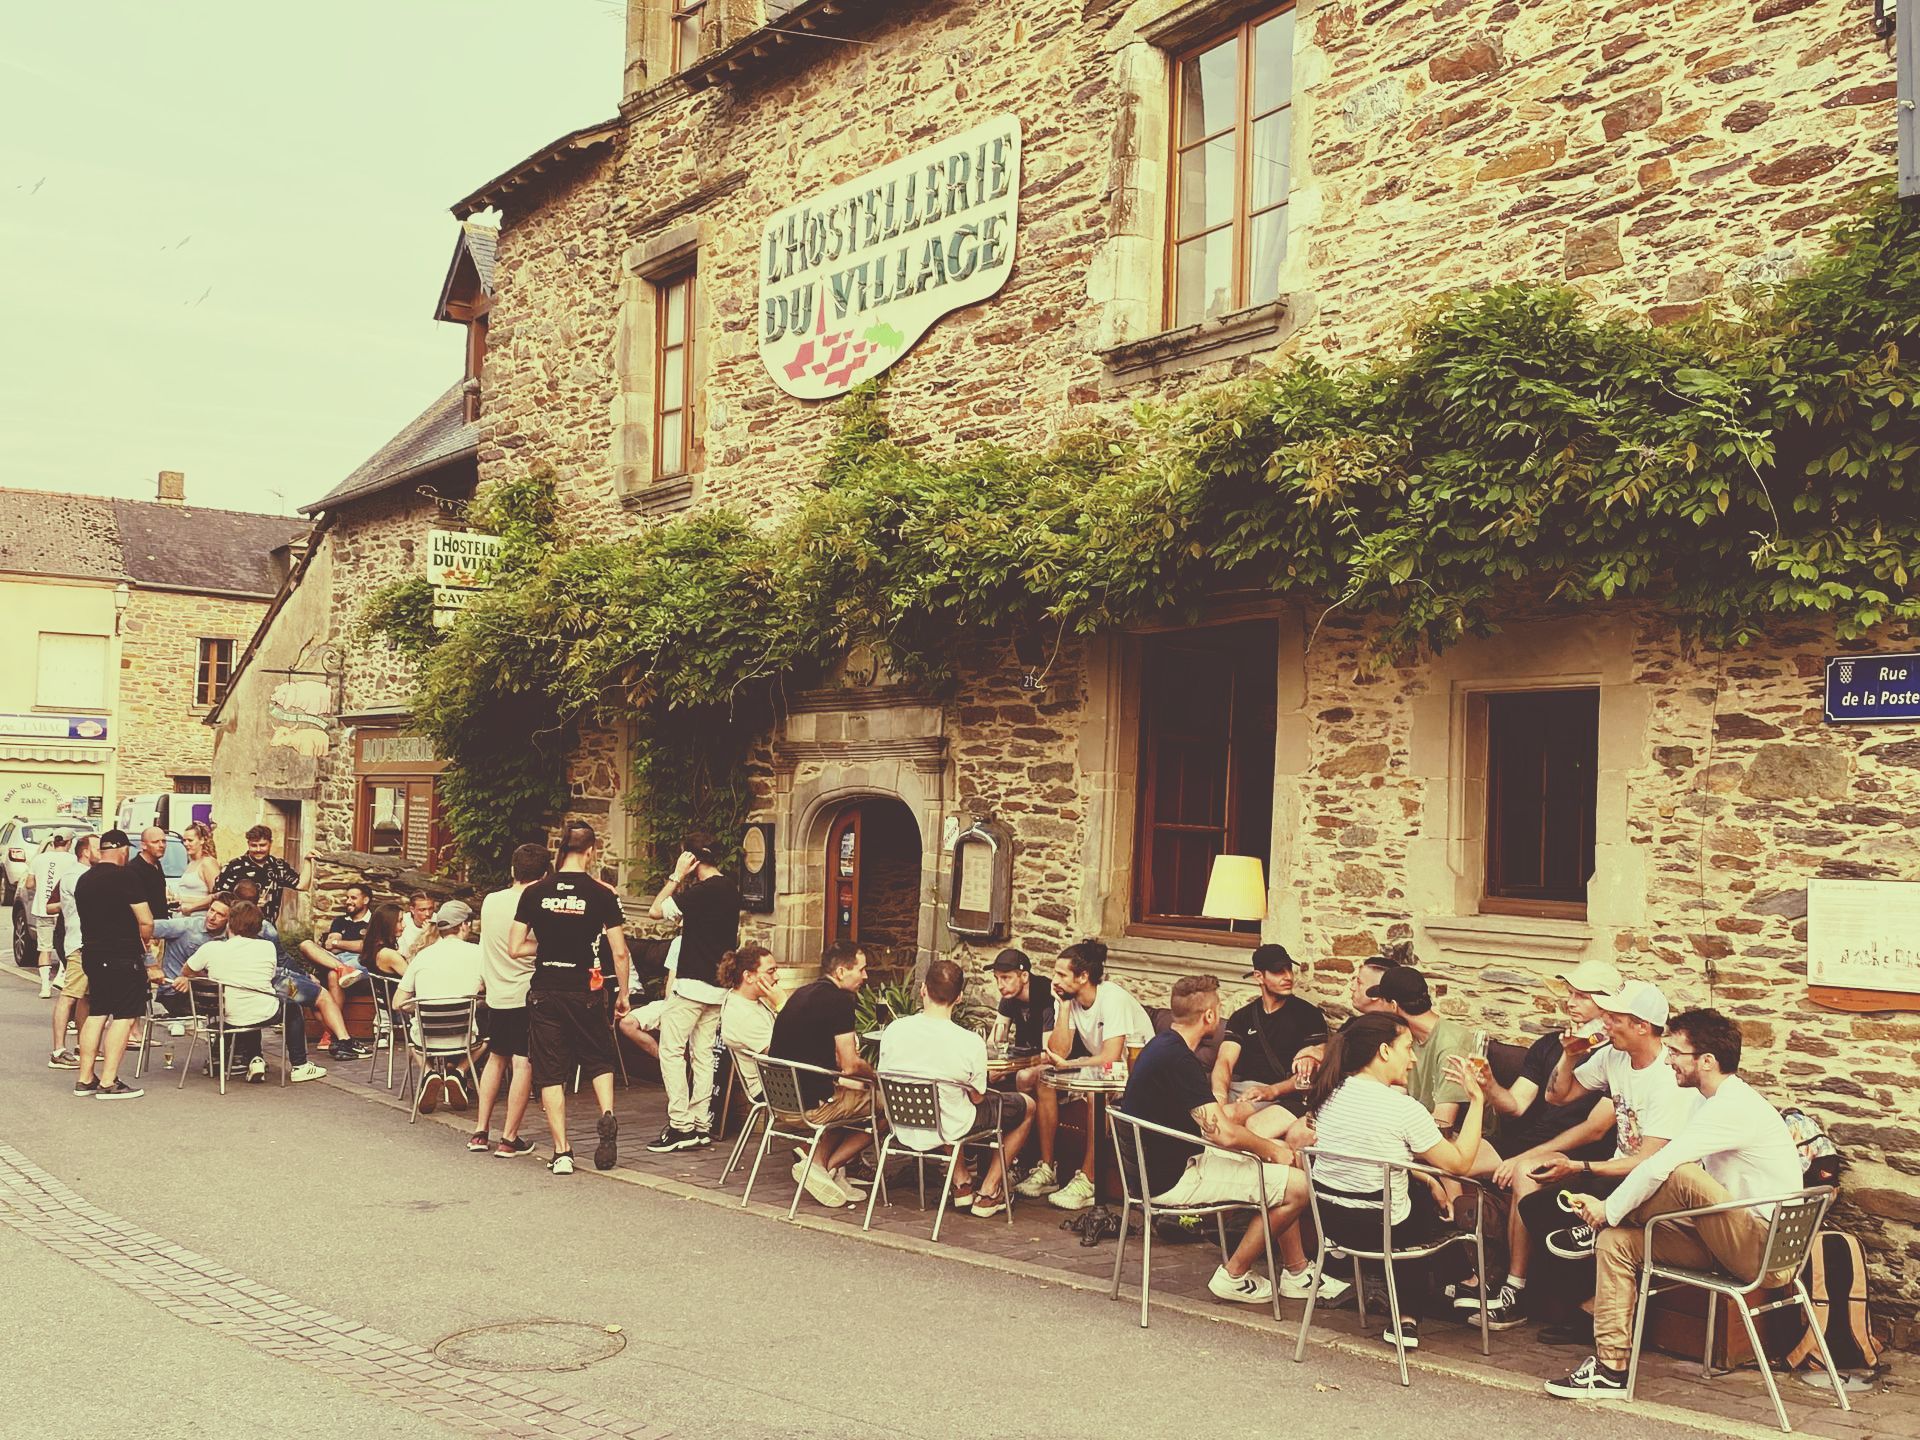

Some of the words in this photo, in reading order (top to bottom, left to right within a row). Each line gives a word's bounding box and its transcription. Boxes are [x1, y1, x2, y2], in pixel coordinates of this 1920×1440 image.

[766, 132, 1013, 286] L'HOSTELLERIE
[764, 281, 815, 345] DU
[829, 210, 1009, 321] VILLAGE
[433, 554, 455, 568] DU
[1879, 666, 1908, 681] Rue
[1841, 691, 1859, 706] de
[1863, 690, 1876, 706] la
[1880, 690, 1920, 705] Poste
[362, 736, 434, 762] BOUCHERIE
[4, 788, 17, 803] BAR
[20, 782, 32, 790] DU
[20, 797, 48, 805] TABAC
